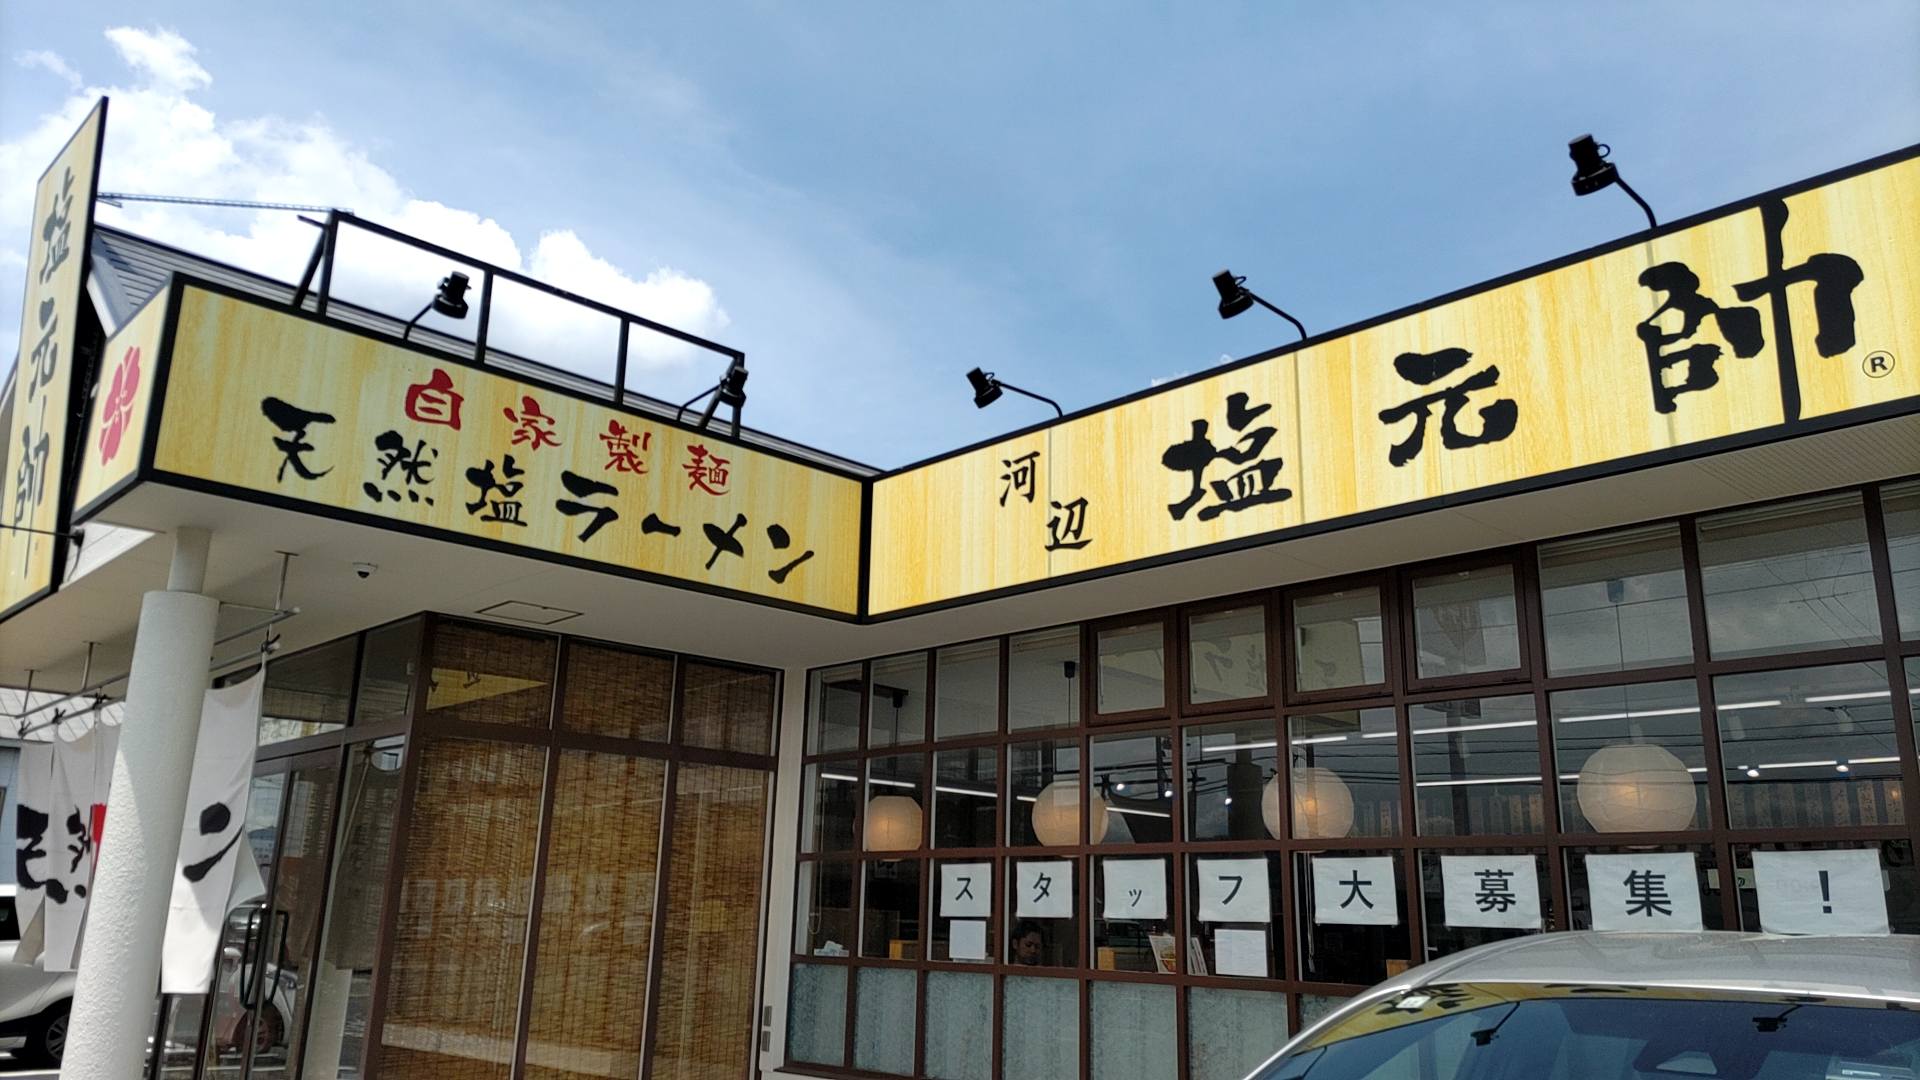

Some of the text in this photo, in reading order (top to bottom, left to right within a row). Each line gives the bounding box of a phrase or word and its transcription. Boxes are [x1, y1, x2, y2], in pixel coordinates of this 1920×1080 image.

[12, 165, 76, 579] 塩元帥
[404, 368, 731, 496] 自家製麺
[1160, 198, 1865, 522] 塩元帥
[261, 396, 815, 584] 天然塩ラーメン
[999, 450, 1094, 552] 河辺
